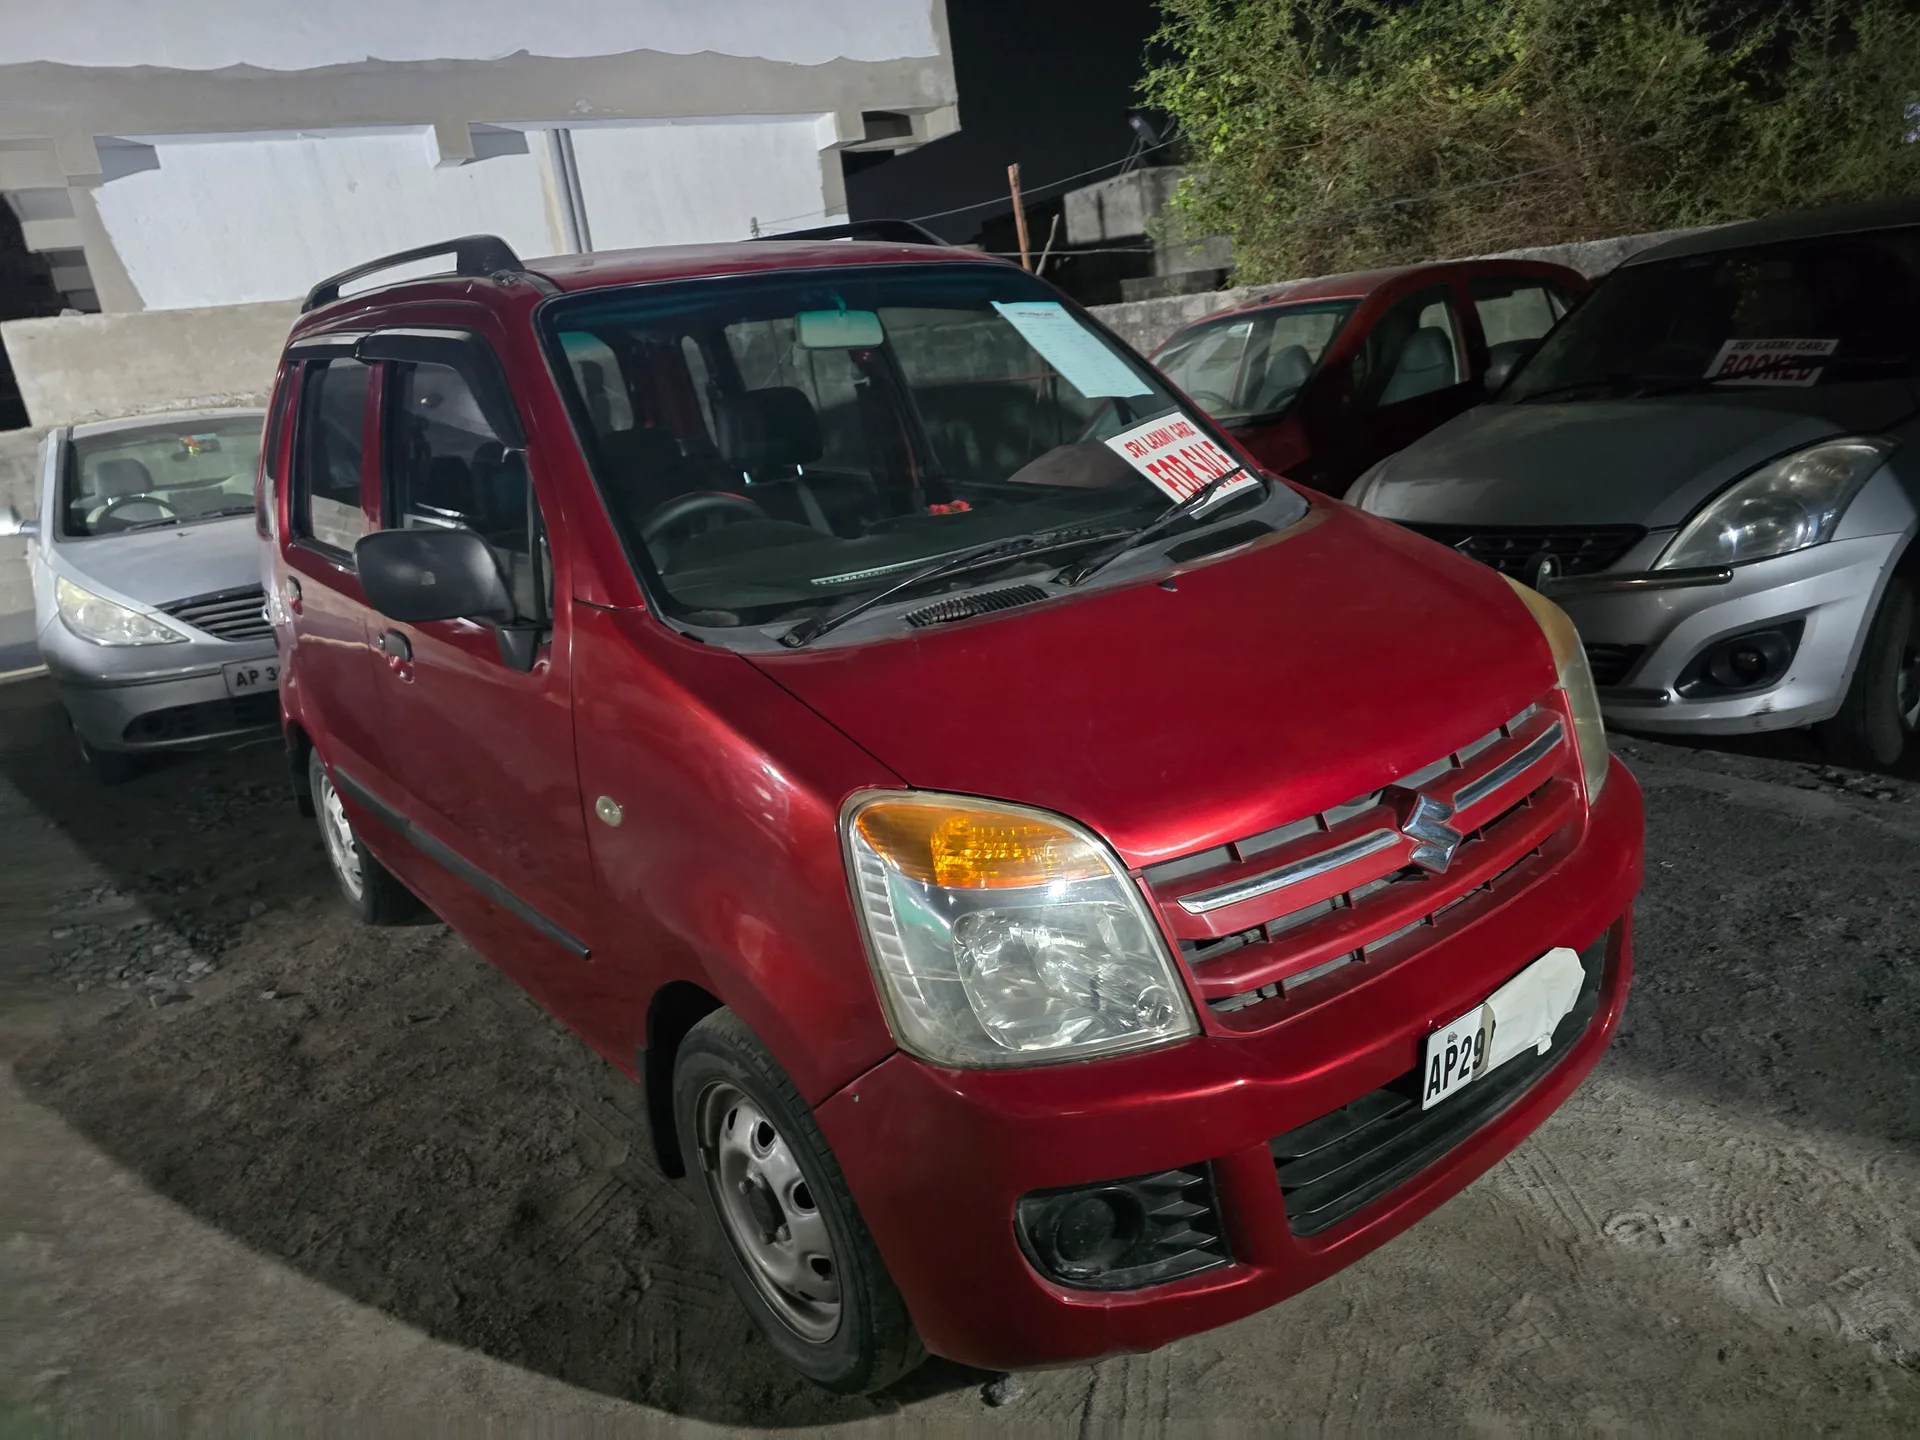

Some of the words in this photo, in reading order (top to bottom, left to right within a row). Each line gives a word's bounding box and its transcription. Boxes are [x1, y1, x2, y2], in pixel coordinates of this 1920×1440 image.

[1732, 342, 1753, 350] SRI
[1755, 341, 1794, 350] LAXMI
[1124, 438, 1150, 458] SRI
[1140, 427, 1177, 449] LAXMI
[1168, 421, 1196, 439] CARZ
[1145, 454, 1207, 501] FOR
[1179, 440, 1248, 488] SALE
[236, 670, 259, 687] AP
[265, 666, 280, 681] 3
[1425, 1019, 1496, 1102] AP29
